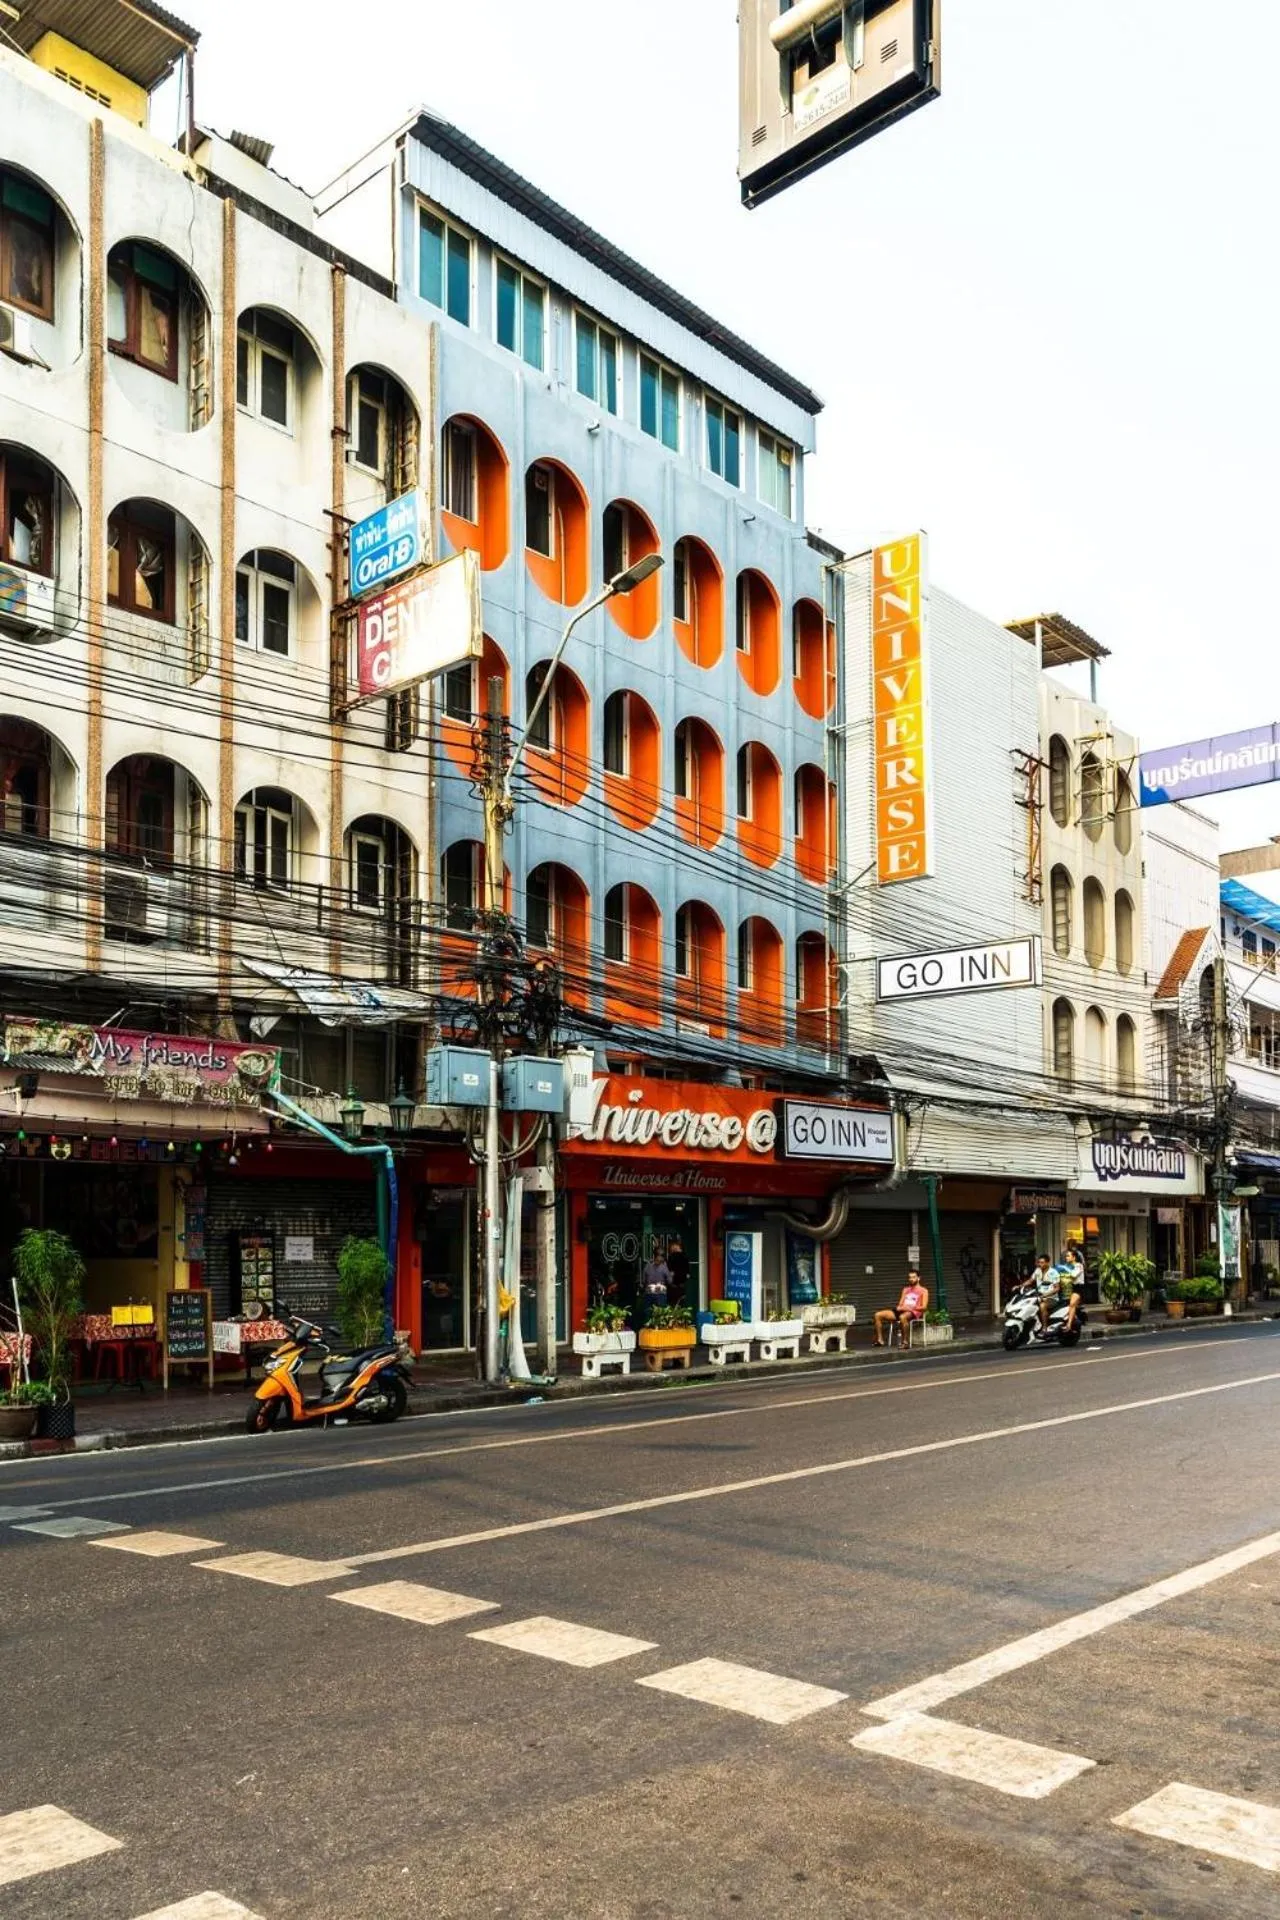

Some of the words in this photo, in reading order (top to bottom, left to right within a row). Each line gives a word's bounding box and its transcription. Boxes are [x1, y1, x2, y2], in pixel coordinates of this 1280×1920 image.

[359, 537, 411, 580] Oral-B
[880, 542, 920, 873] UNIVERSE
[896, 959, 943, 990] GO
[960, 950, 1012, 981] INN
[90, 1034, 131, 1066] My
[141, 1035, 227, 1070] friends
[746, 1109, 778, 1153] @
[792, 1115, 827, 1145] GO
[832, 1118, 866, 1148] INN
[604, 1166, 669, 1186] Universe
[685, 1169, 728, 1189] Home
[602, 1232, 640, 1263] GO
